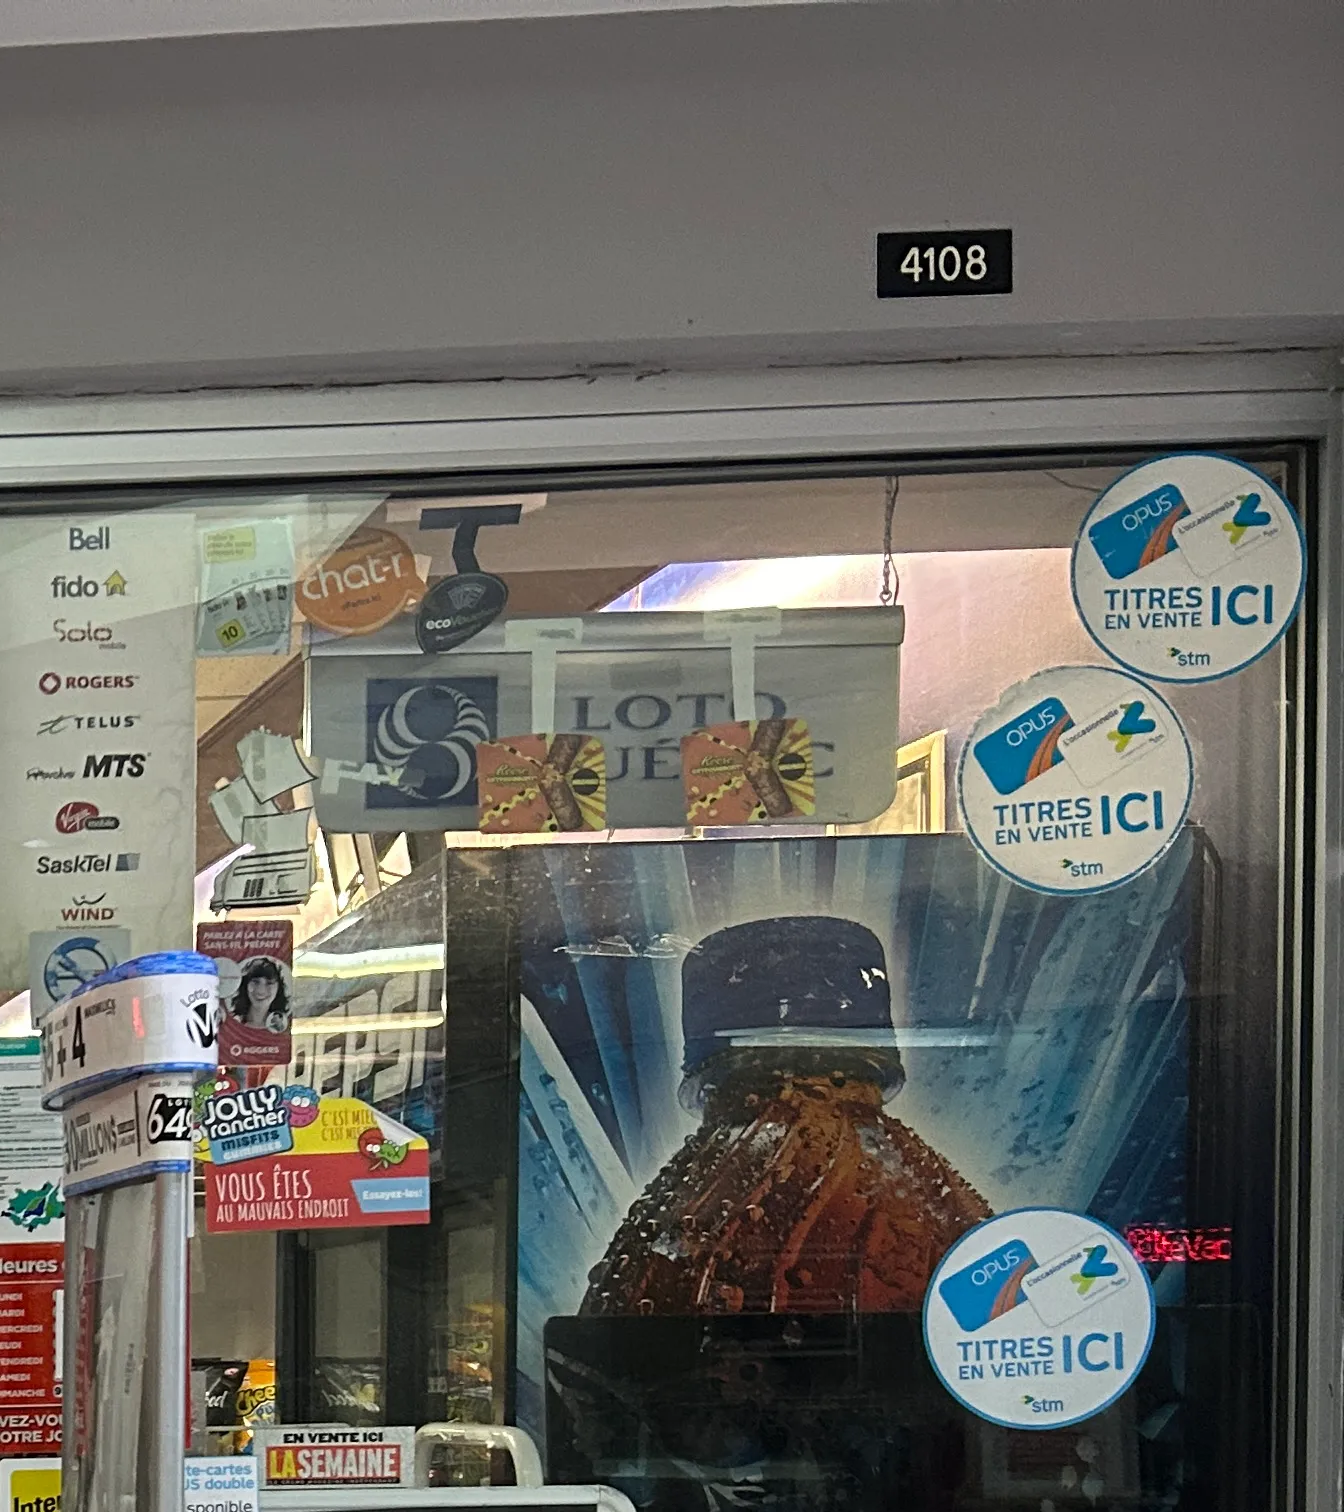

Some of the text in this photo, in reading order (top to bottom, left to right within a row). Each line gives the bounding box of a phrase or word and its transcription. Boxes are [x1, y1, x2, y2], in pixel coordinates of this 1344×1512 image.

[900, 245, 987, 282] 4108
[1121, 492, 1172, 531] OPUS
[70, 527, 110, 550] Bell
[51, 575, 98, 598] fido
[1105, 584, 1273, 625] TITRES ICI
[53, 619, 112, 642] Solo
[1105, 612, 1202, 629] EN VENTE
[222, 626, 239, 640] 10
[1178, 651, 1210, 666] stm
[66, 676, 135, 689] ROGERS
[75, 716, 135, 729] TELUS
[1006, 707, 1056, 746] OPUS
[83, 754, 146, 778] MTS
[993, 790, 1164, 835] TITRES ICI
[995, 822, 1092, 845] EN VENTE
[37, 854, 111, 874] SaskTel
[1071, 860, 1103, 877] stm
[61, 908, 114, 921] WIND
[73, 1006, 86, 1067] 4
[205, 1087, 278, 1125] JOLLY
[210, 1108, 286, 1140] rancher
[216, 1164, 312, 1202] VOUS ÊTES
[216, 1198, 349, 1223] AU MAUVAIS ENDROIT
[971, 1249, 1020, 1286] OPUS
[957, 1332, 1124, 1373] TITRES ICI
[959, 1361, 1054, 1380] EN VENTE
[1032, 1397, 1064, 1412] stm
[284, 1432, 383, 1443] EN VENTE ICI
[186, 1464, 251, 1476] te-cartes
[269, 1447, 397, 1479] LA SEMAINE
[205, 1476, 254, 1489] double
